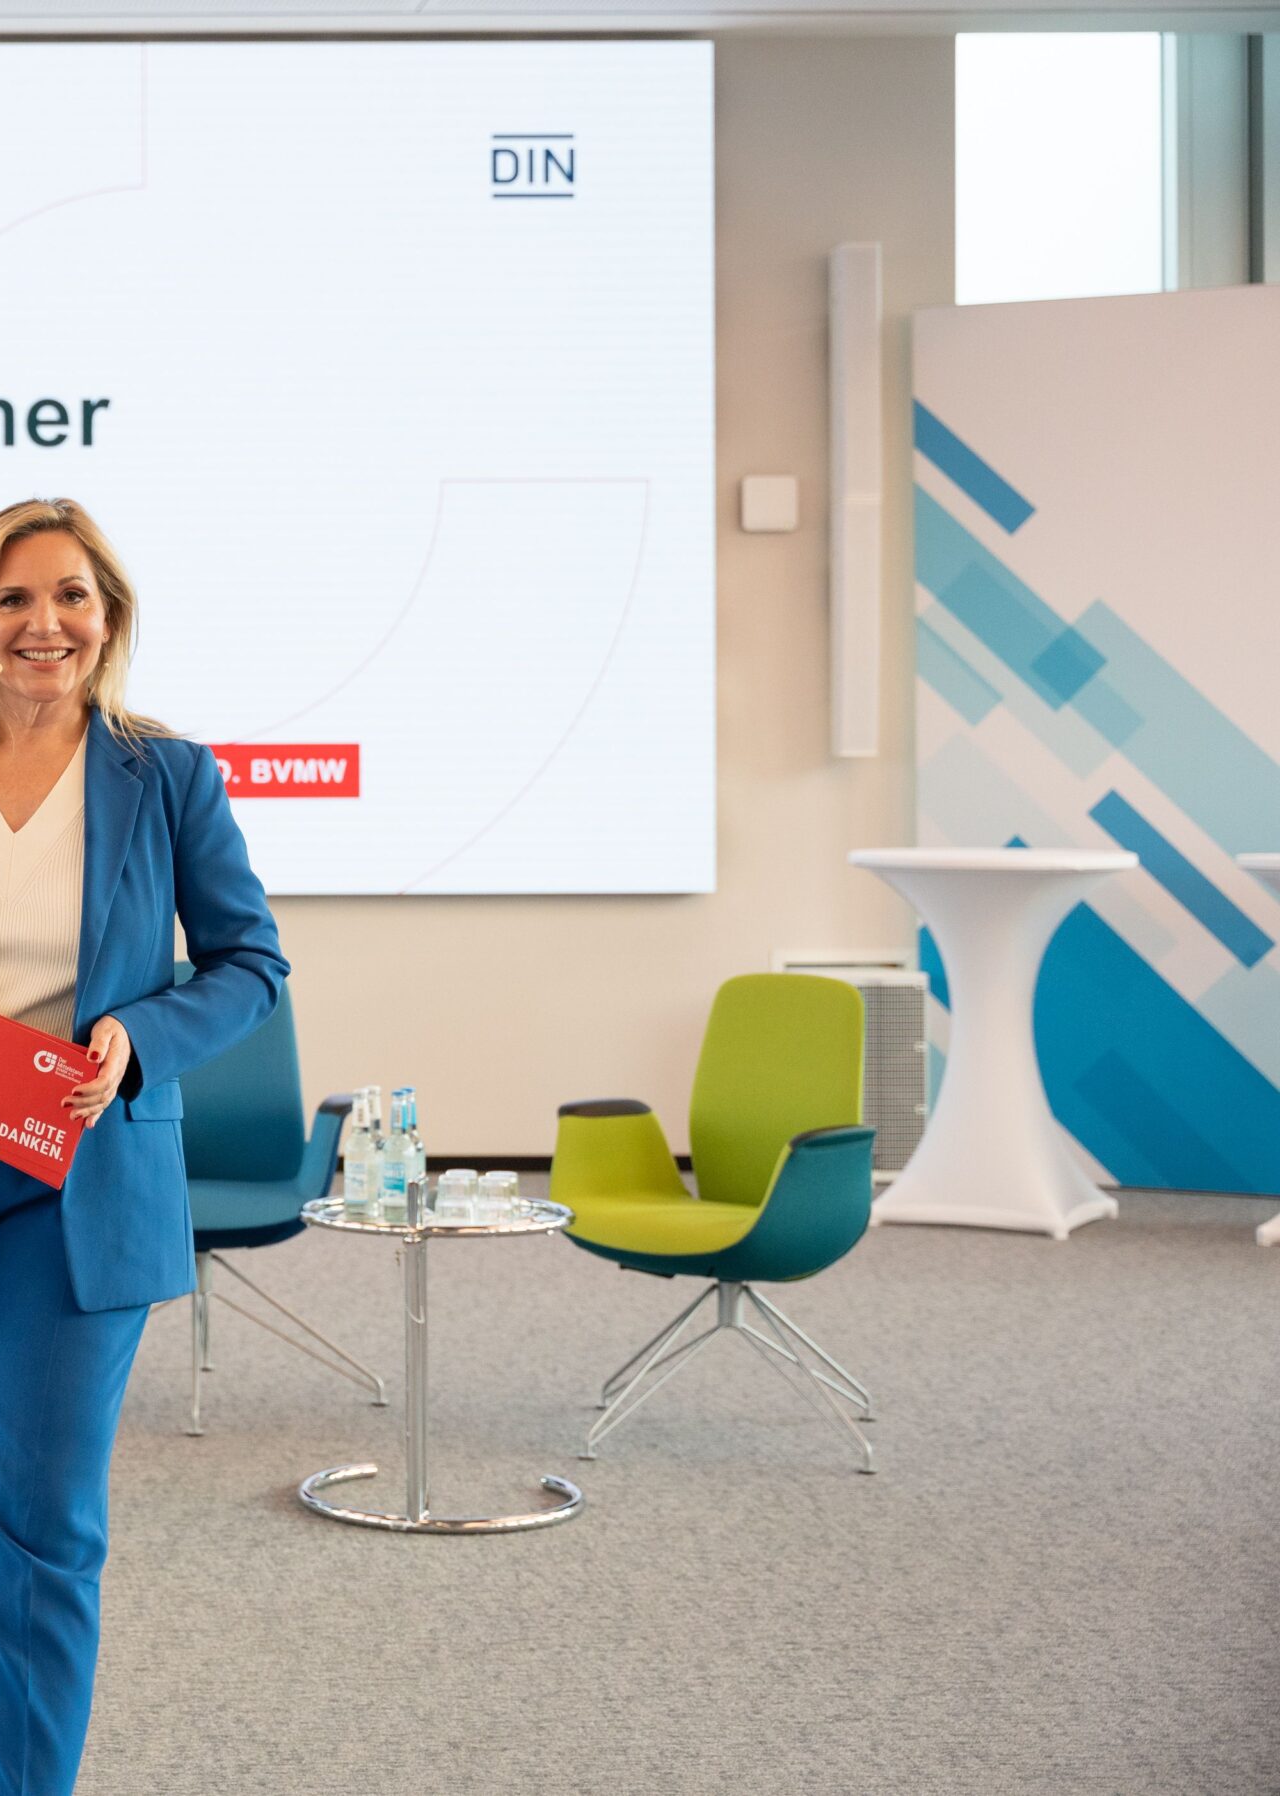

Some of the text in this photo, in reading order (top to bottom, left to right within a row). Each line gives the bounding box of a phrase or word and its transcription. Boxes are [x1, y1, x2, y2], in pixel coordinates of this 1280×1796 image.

[492, 148, 574, 184] DIN
[250, 758, 347, 784] BVMW
[23, 1116, 67, 1145] GUTE
